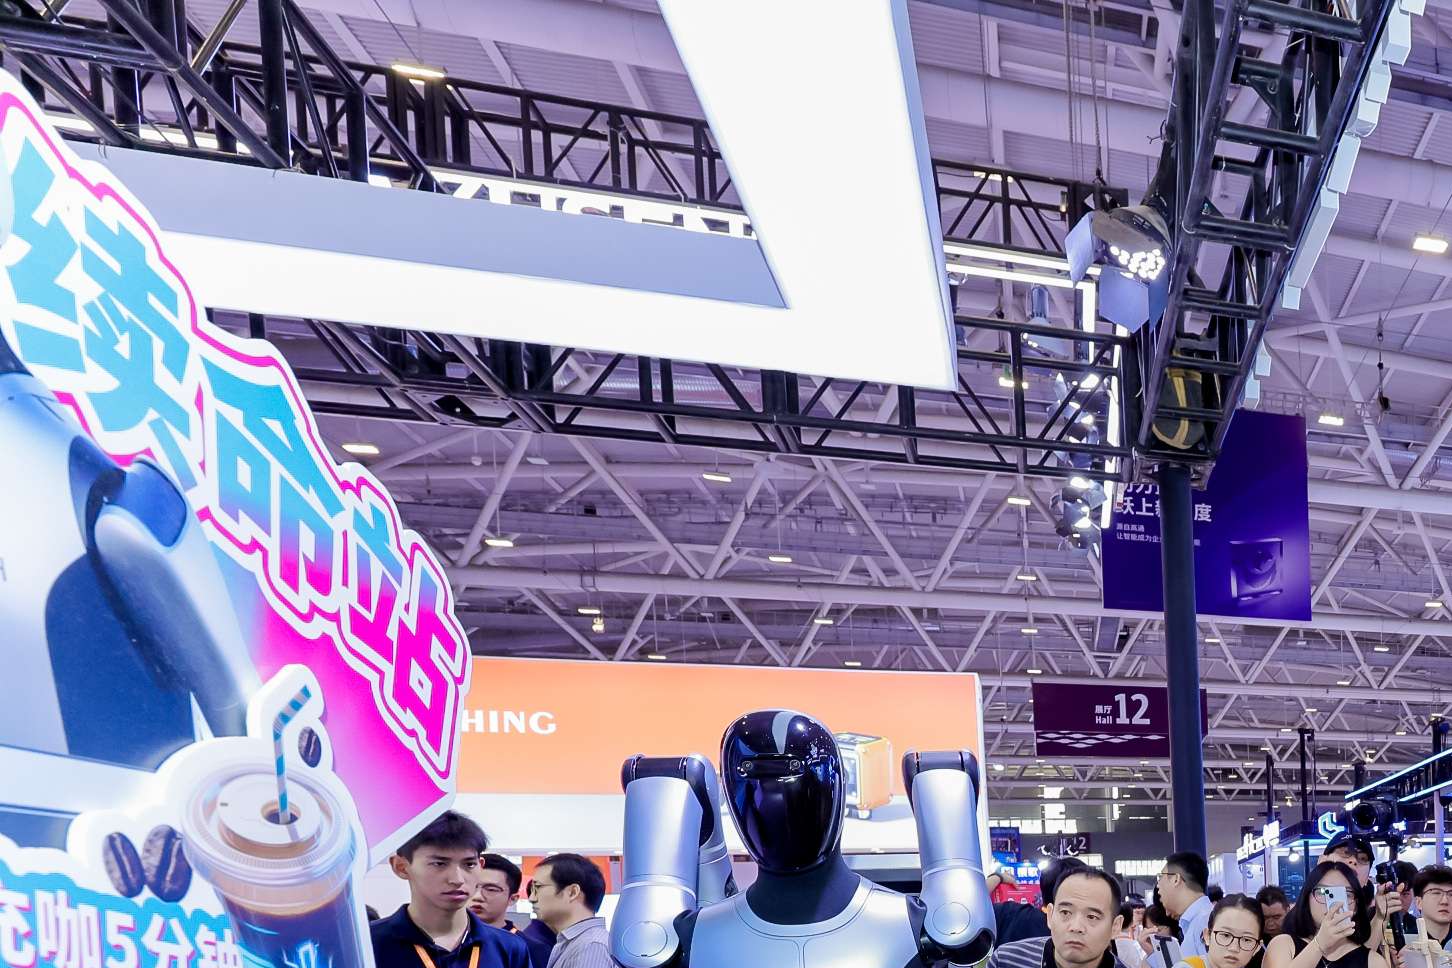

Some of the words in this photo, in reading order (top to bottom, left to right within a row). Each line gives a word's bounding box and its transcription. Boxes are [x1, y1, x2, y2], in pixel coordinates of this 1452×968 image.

[1095, 705, 1112, 714] 展厅
[1115, 693, 1151, 725] 12
[1096, 716, 1113, 725] Hall
